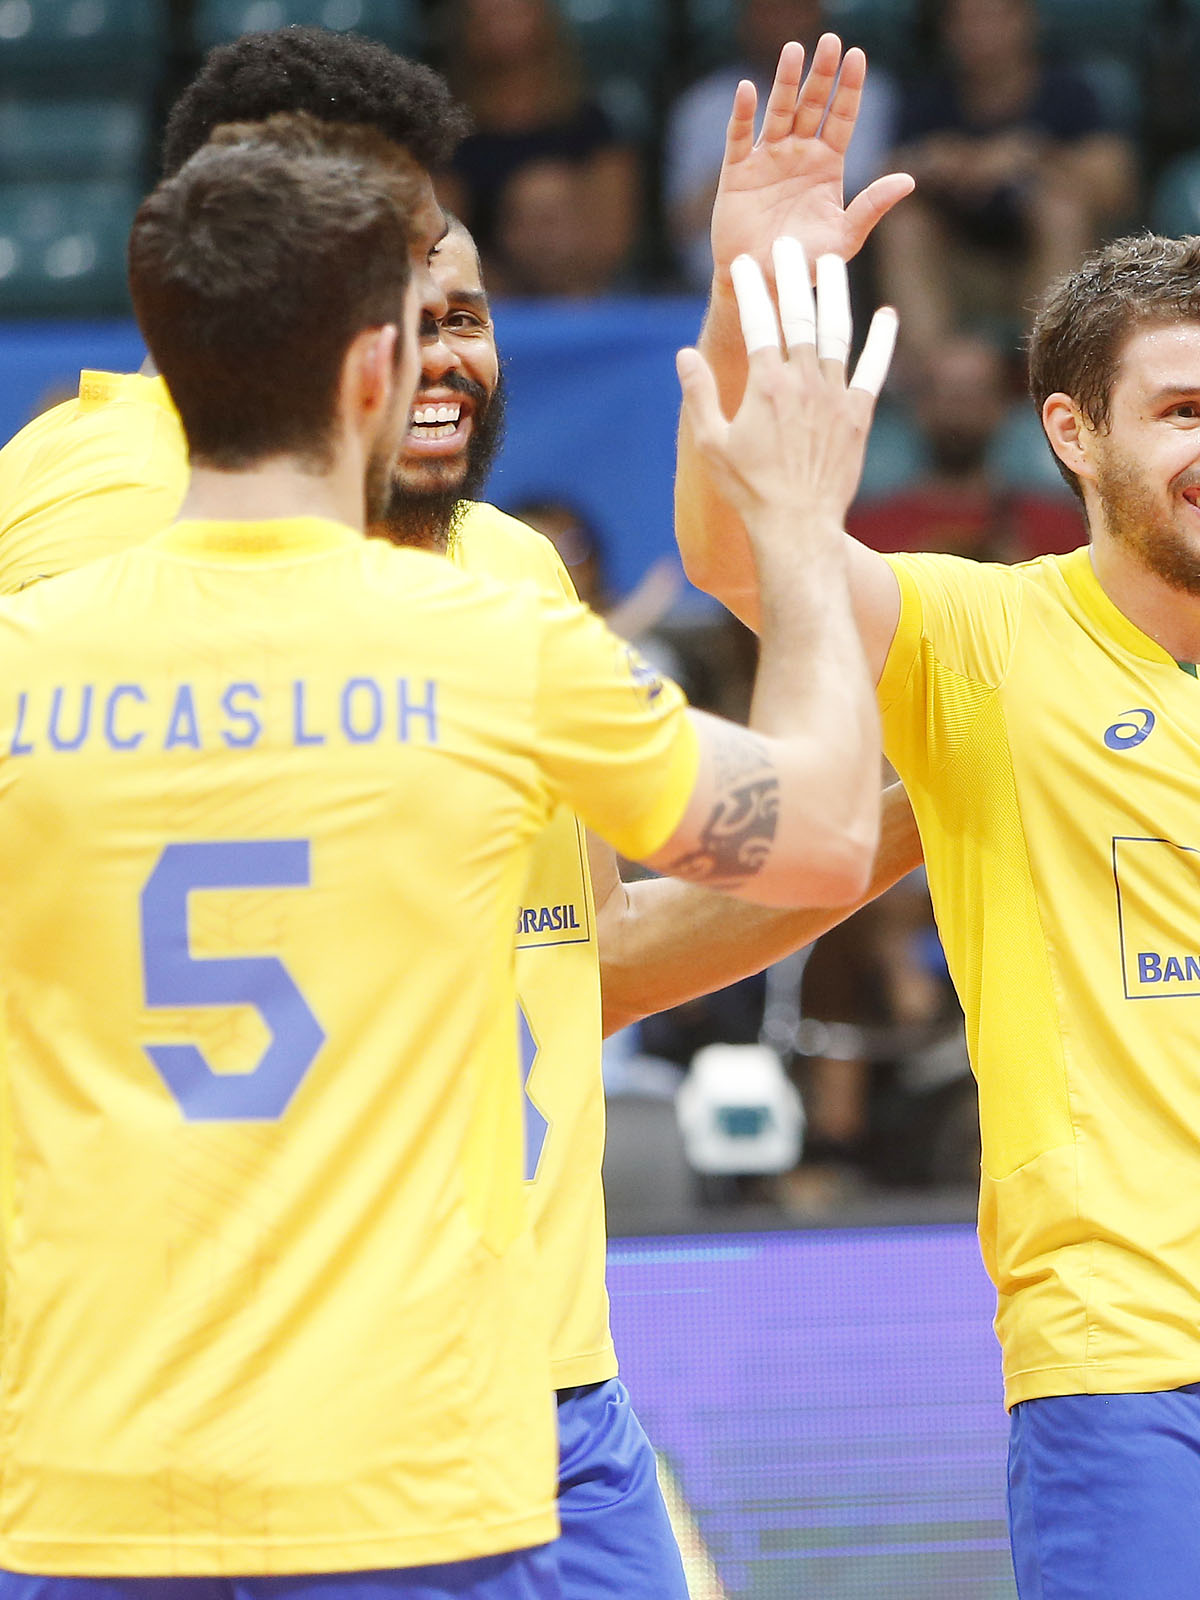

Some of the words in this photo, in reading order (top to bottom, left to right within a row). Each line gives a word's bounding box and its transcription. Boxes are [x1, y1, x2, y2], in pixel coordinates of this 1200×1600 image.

[10, 682, 262, 756] LUCAS
[292, 677, 438, 746] LOH
[139, 838, 326, 1121] 5
